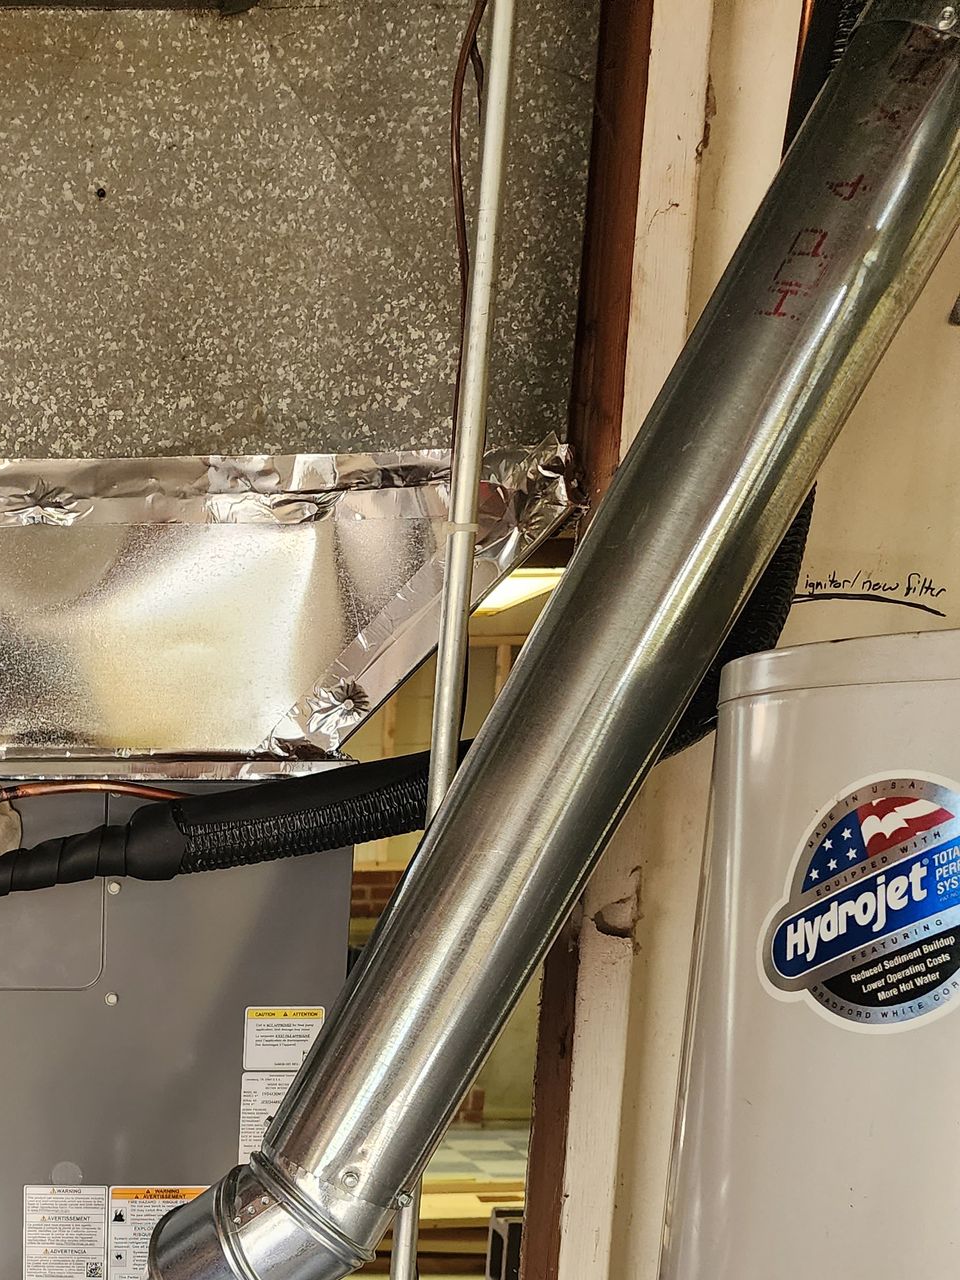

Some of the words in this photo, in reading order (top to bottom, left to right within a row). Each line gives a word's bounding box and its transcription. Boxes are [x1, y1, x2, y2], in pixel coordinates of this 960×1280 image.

[904, 573, 946, 597] filter
[808, 814, 834, 849] MADE
[845, 796, 858, 807] IN
[872, 781, 923, 793] U.S.A.
[816, 856, 888, 897] EQUIPPED
[900, 831, 941, 854] WITH
[787, 862, 927, 961] Hydrojet
[851, 919, 943, 962] FEATURING
[851, 963, 882, 983] Reduced
[884, 948, 921, 970] Sediment
[922, 935, 955, 954] Buildup
[862, 979, 886, 993] Lower
[887, 962, 925, 983] Operating
[927, 953, 951, 968] Costs
[877, 986, 898, 1001] More
[899, 981, 914, 994] Hot
[914, 971, 941, 989] Water
[811, 986, 871, 1019] BRADFORD
[881, 1003, 924, 1018] WHITE
